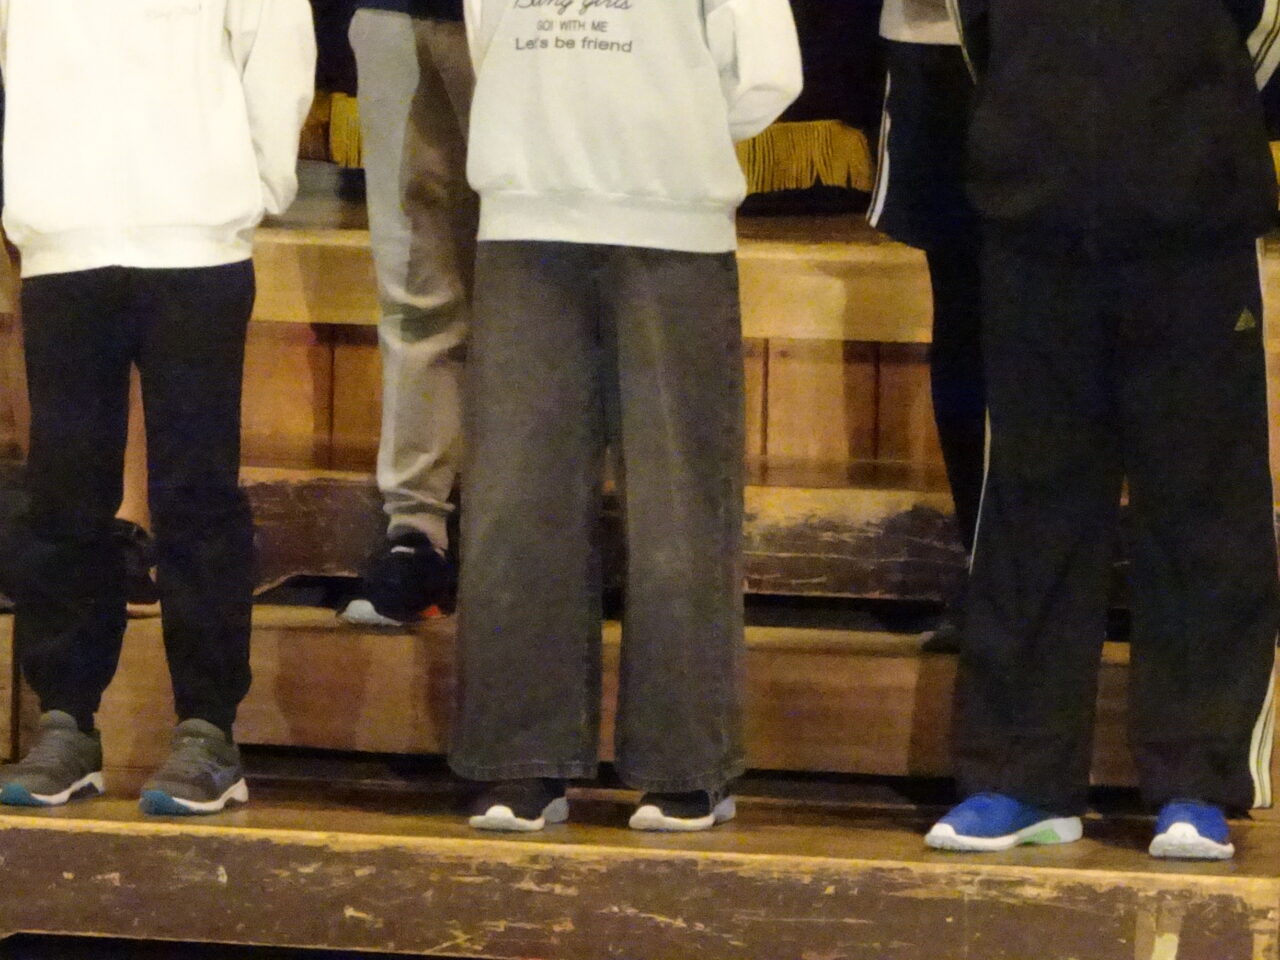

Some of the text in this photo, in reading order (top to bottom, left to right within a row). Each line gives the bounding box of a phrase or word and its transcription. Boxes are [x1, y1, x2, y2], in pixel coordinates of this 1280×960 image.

[560, 20, 586, 31] WITH
[591, 21, 608, 32] ME
[555, 36, 576, 49] be
[581, 37, 632, 52] friend
